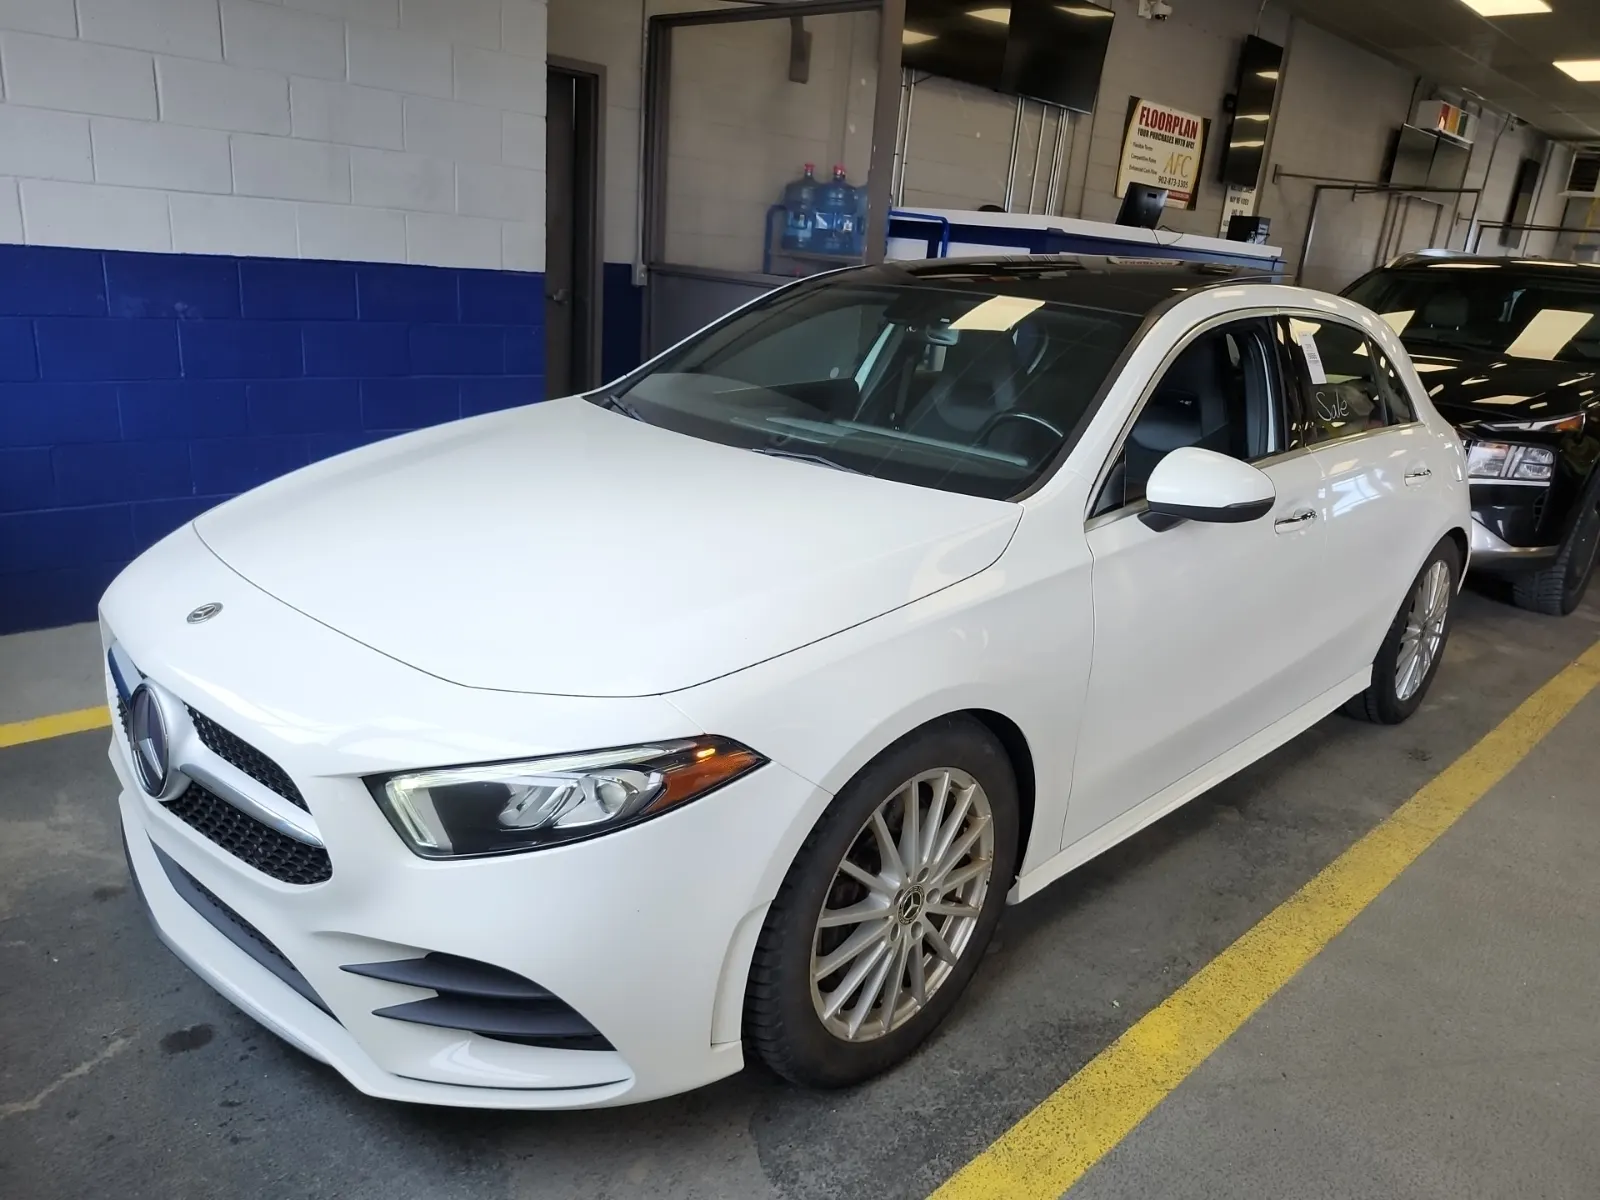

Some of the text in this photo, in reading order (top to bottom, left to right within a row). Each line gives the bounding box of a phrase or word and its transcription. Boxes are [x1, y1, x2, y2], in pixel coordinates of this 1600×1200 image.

[1139, 106, 1199, 140] FLOORPLAN
[1137, 127, 1150, 139] YOUR
[1149, 130, 1175, 144] PURCHASES
[1174, 138, 1186, 148] WITH
[1163, 151, 1192, 178] AFC
